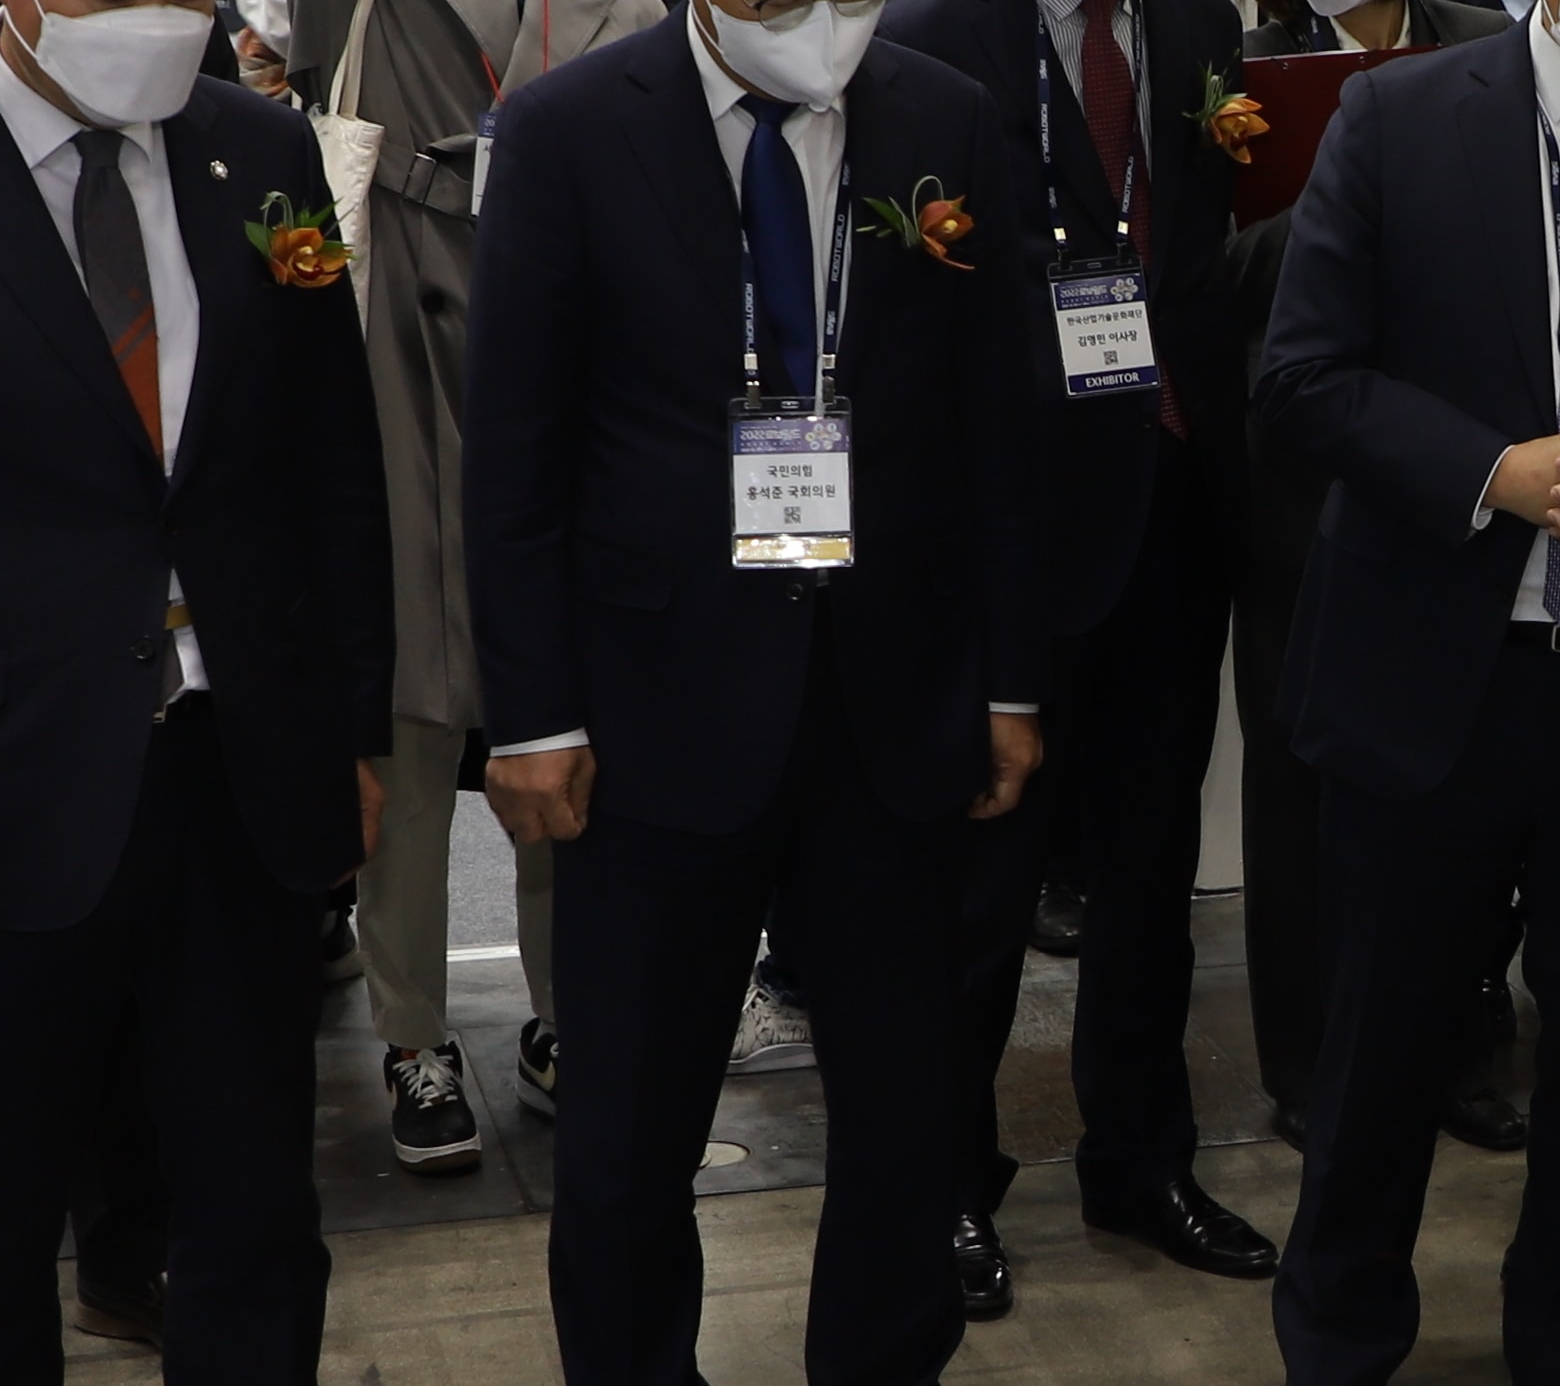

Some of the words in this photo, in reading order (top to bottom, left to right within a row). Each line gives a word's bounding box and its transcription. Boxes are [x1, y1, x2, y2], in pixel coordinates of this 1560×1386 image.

[831, 213, 845, 282] ROBOTWORLD
[744, 282, 754, 354] ROBOTWORL
[1108, 329, 1138, 343] 이사장
[1085, 371, 1140, 389] EXHIBITOR
[767, 464, 813, 478] 국민의힘
[747, 485, 783, 501] 홍석준
[787, 484, 836, 499] 국회의원
